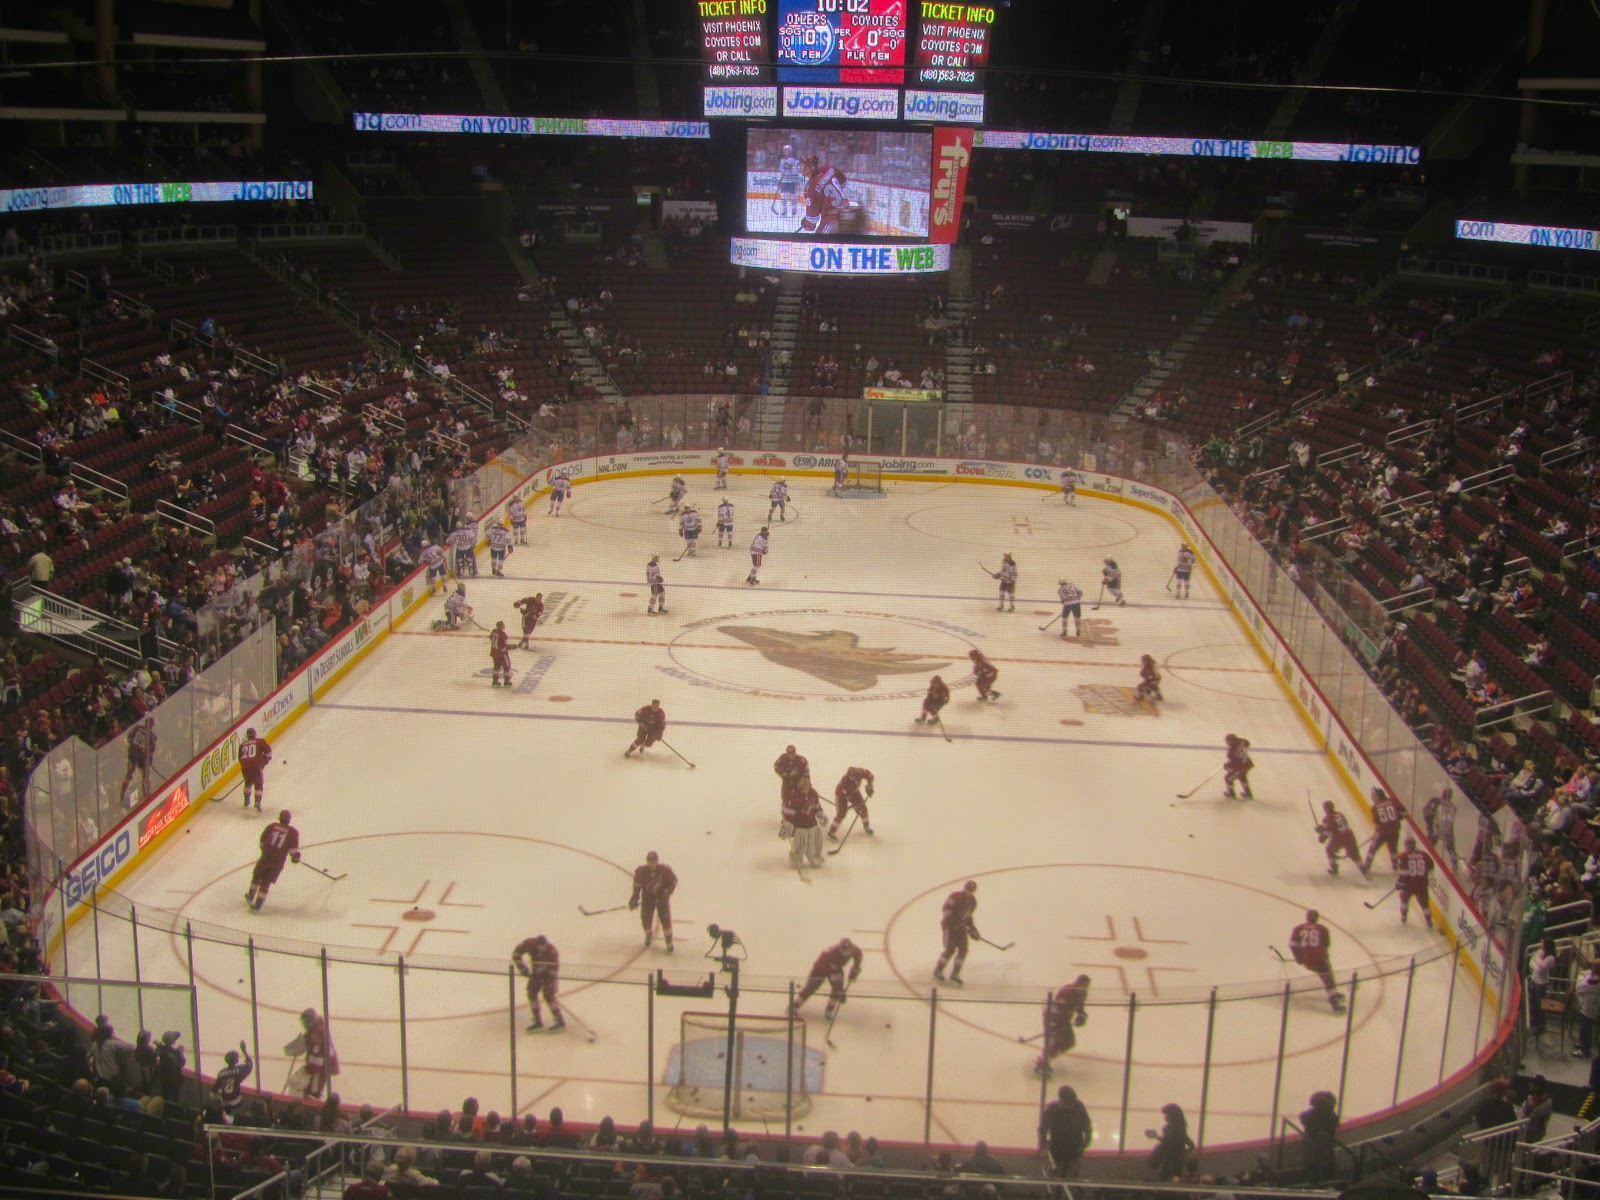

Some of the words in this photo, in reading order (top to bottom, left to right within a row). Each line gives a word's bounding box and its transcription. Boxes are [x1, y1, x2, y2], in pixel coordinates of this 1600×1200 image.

[698, 1, 736, 16] TICKET
[740, 0, 766, 15] INFO
[817, 0, 869, 12] 10:02
[786, 14, 827, 25] OILERS
[921, 2, 964, 20] TICKET
[967, 6, 995, 24] INFO
[703, 22, 723, 33] VISIT
[725, 20, 761, 32] PHOENIX
[851, 15, 899, 27] COYOTES
[778, 27, 802, 36] SOG
[805, 29, 816, 45] 0
[834, 28, 852, 37] PER
[867, 30, 878, 46] 0
[882, 29, 905, 38] SOG
[922, 24, 946, 36] VISIT
[947, 26, 986, 40] PHOENIX
[705, 37, 741, 47] COYOTES
[743, 36, 761, 46] COM
[838, 40, 845, 50] 1
[921, 39, 961, 52] COYOTES
[716, 51, 728, 61] OR
[731, 50, 751, 61] CALL
[778, 50, 797, 58] PLR
[802, 50, 821, 59] PEN
[847, 51, 866, 60] PLR
[870, 52, 890, 60] PEN
[931, 55, 944, 66] OR
[706, 90, 774, 113] Jobing.com
[787, 91, 895, 115] Jobing.com
[907, 95, 981, 118] Jobing.com
[461, 118, 483, 133] ON
[486, 117, 530, 134] YOUR
[534, 117, 588, 133] PHONE
[1021, 133, 1125, 150] Jobing.com
[1193, 140, 1215, 156] ON
[1219, 141, 1251, 158] THE
[1255, 142, 1294, 159] WEB
[113, 185, 132, 204] ON
[135, 183, 160, 203] THE
[161, 182, 192, 202] WEB
[1529, 228, 1551, 247] ON
[1554, 230, 1593, 248] YOUR
[810, 246, 842, 270] ON
[847, 247, 891, 270] THE
[896, 246, 934, 270] WEB
[598, 462, 628, 473] NHL.COM
[797, 457, 811, 466] FOX
[880, 459, 935, 470] Jobing.com
[956, 464, 985, 475] Coors
[1025, 467, 1052, 480] COX
[1092, 482, 1121, 494] NHL.COM
[241, 743, 257, 760] 20
[140, 817, 164, 843] PHOENIX
[164, 797, 188, 823] COYOTES
[1378, 804, 1397, 823] 50
[66, 830, 131, 908] GEICO
[1299, 930, 1320, 948] 26
